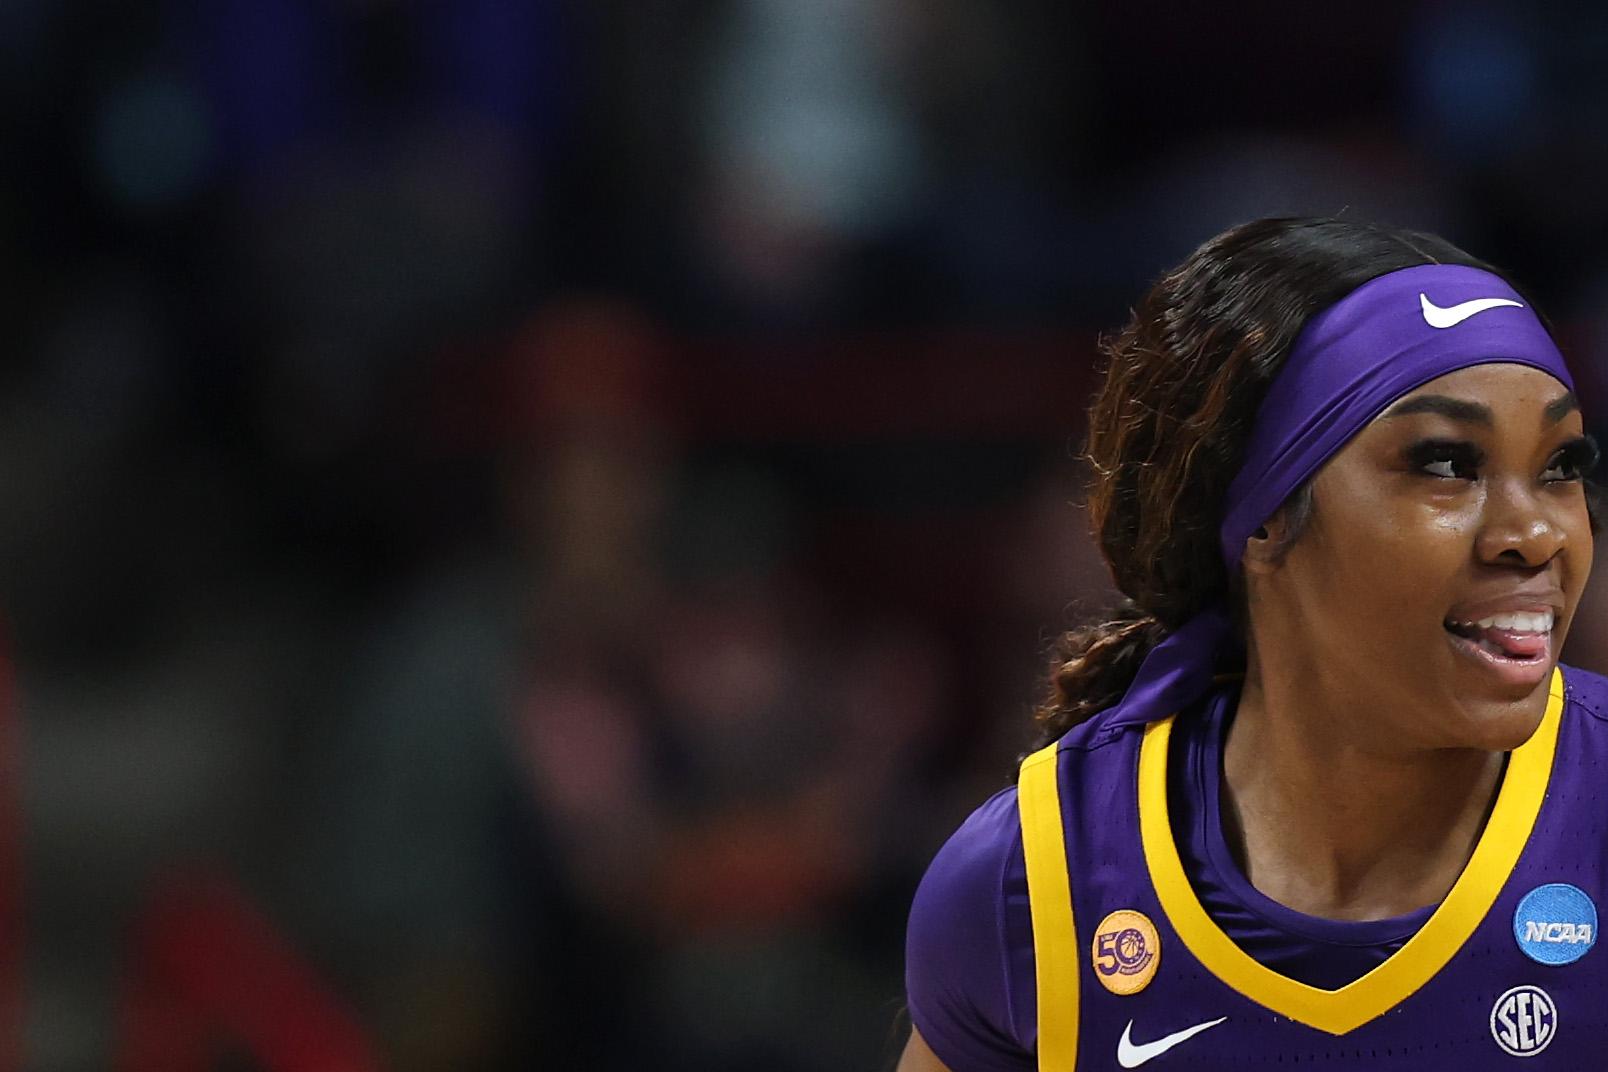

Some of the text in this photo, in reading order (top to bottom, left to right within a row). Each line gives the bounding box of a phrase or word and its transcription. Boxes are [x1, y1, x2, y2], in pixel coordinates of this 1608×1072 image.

[1098, 928, 1145, 976] 50
[1525, 921, 1592, 944] NCAA
[1498, 992, 1550, 1050] SEC
